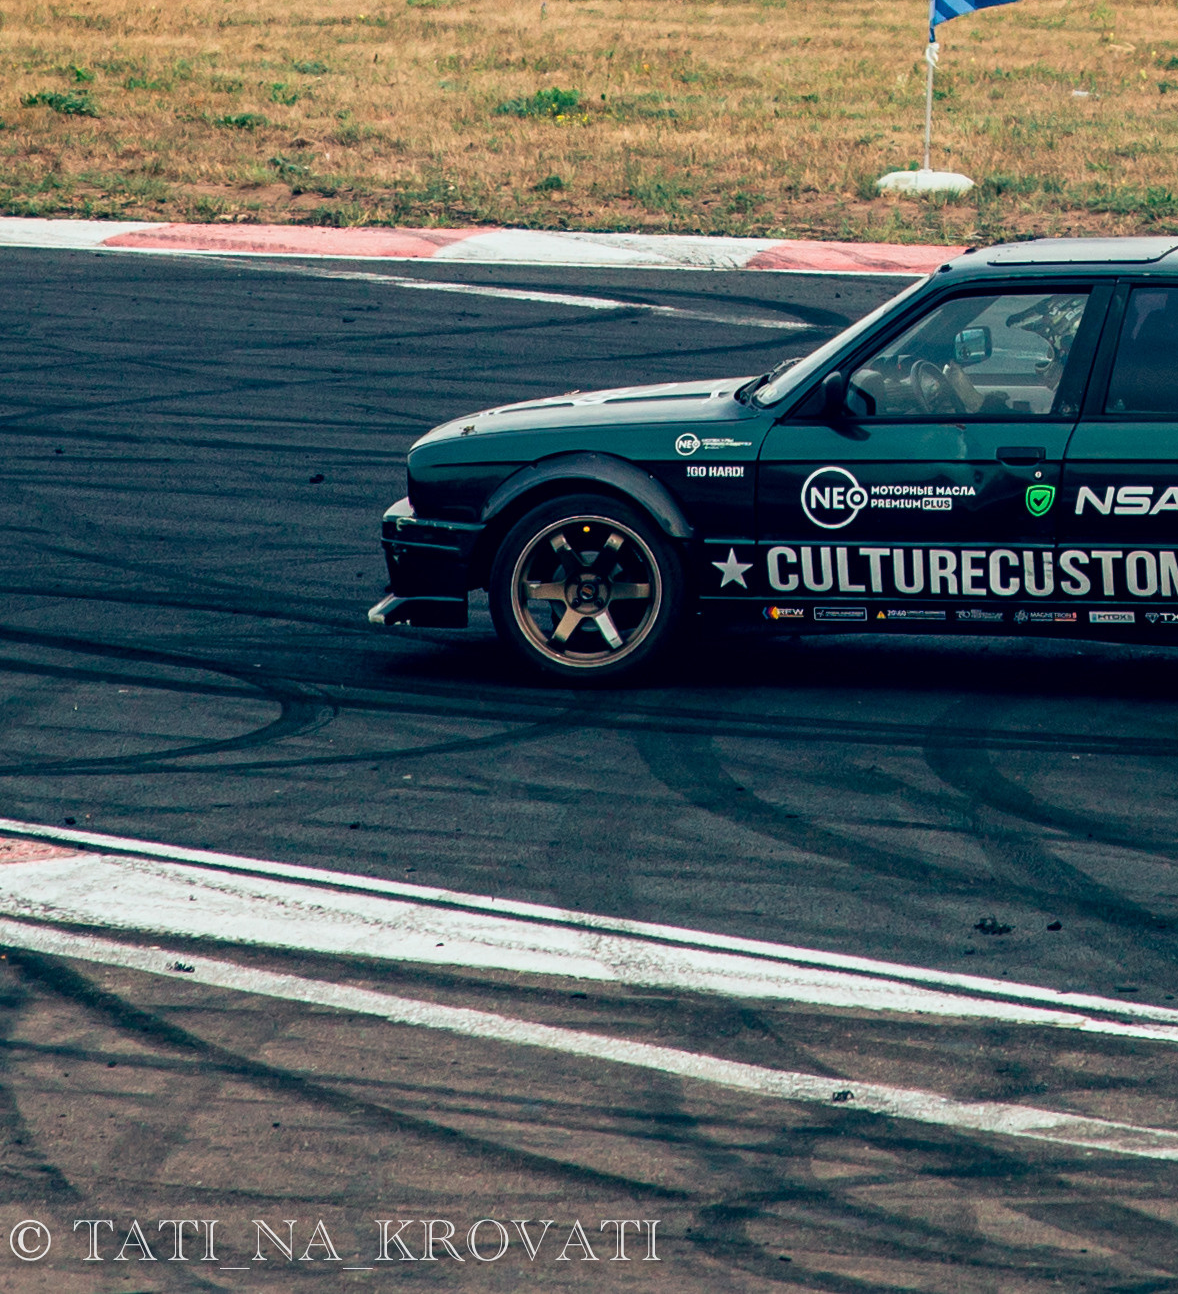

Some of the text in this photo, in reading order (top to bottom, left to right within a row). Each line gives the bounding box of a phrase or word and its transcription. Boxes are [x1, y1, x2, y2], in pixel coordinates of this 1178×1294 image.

[708, 466, 745, 478] HARD!
[871, 486, 976, 496] МОТОРНЫЕ МАСЛА
[810, 486, 869, 510] NEO
[870, 498, 952, 510] PREMIUM PLUS
